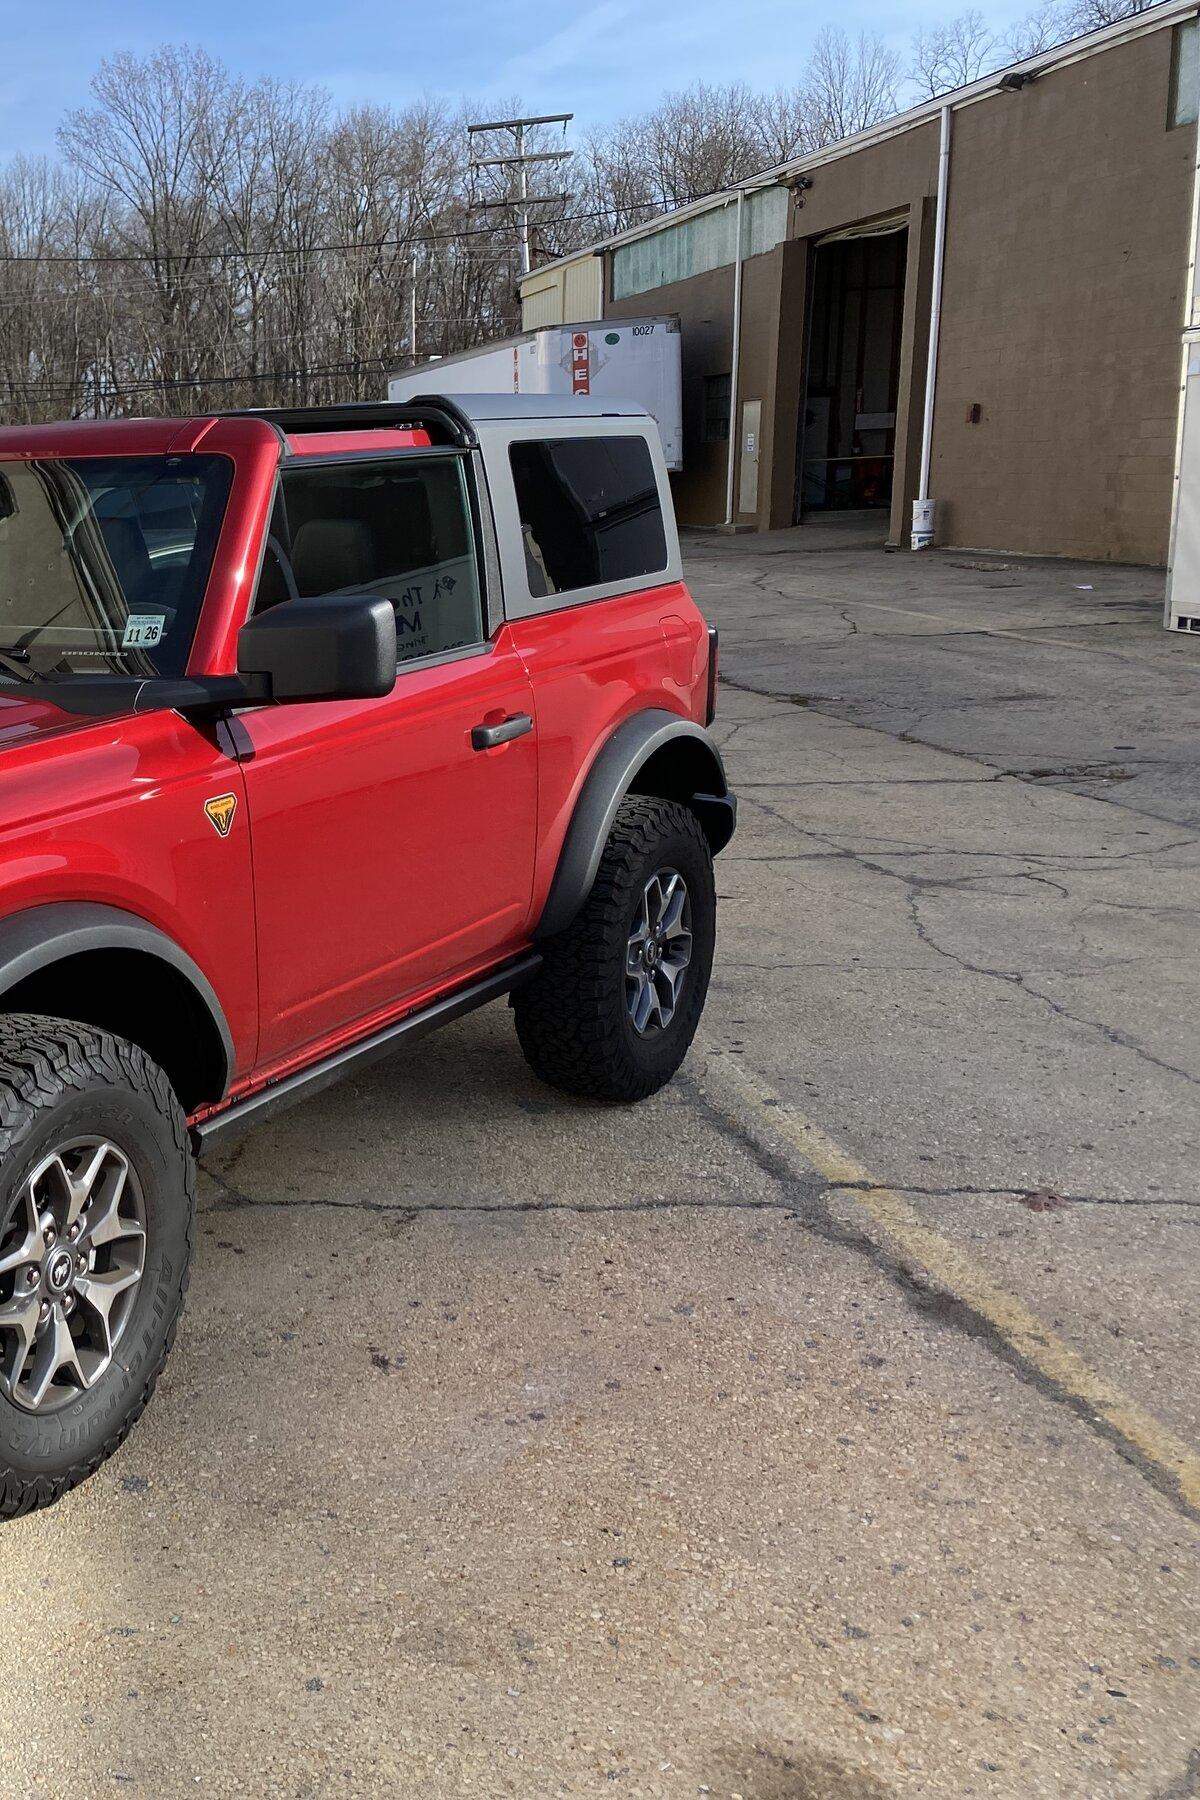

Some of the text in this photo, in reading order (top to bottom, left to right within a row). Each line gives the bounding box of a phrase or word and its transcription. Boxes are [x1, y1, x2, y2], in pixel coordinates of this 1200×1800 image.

[632, 326, 655, 336] 10027
[127, 626, 158, 642] 11 26
